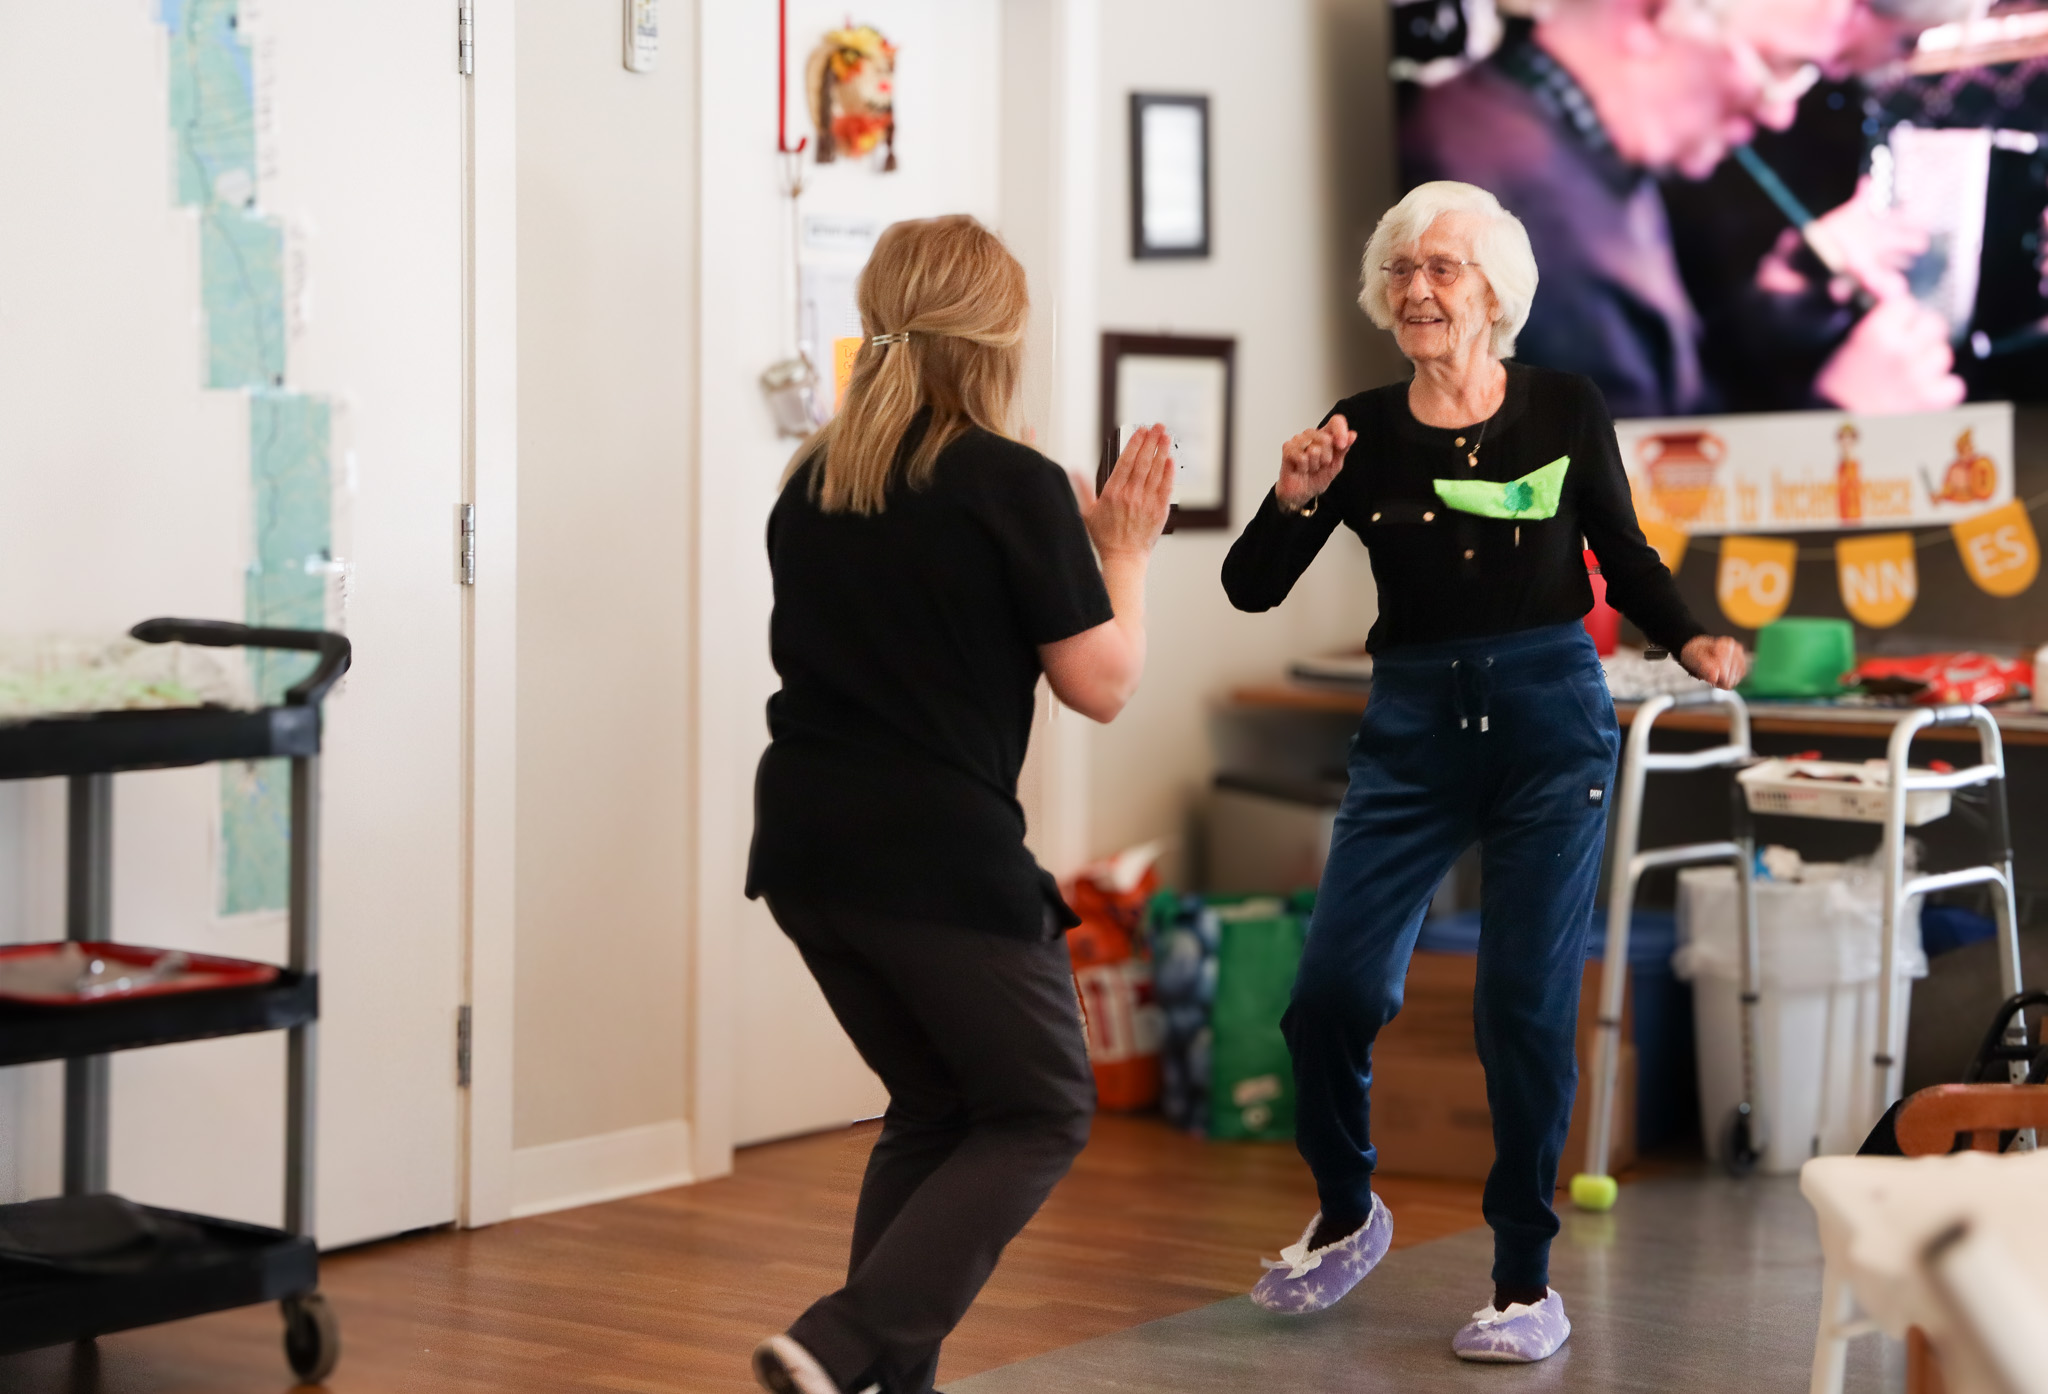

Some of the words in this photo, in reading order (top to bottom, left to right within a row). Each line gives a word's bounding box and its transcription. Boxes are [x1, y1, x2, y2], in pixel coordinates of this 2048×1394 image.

[1718, 556, 1789, 606] PO
[1842, 557, 1917, 607] NN
[1968, 525, 2029, 579] ES
